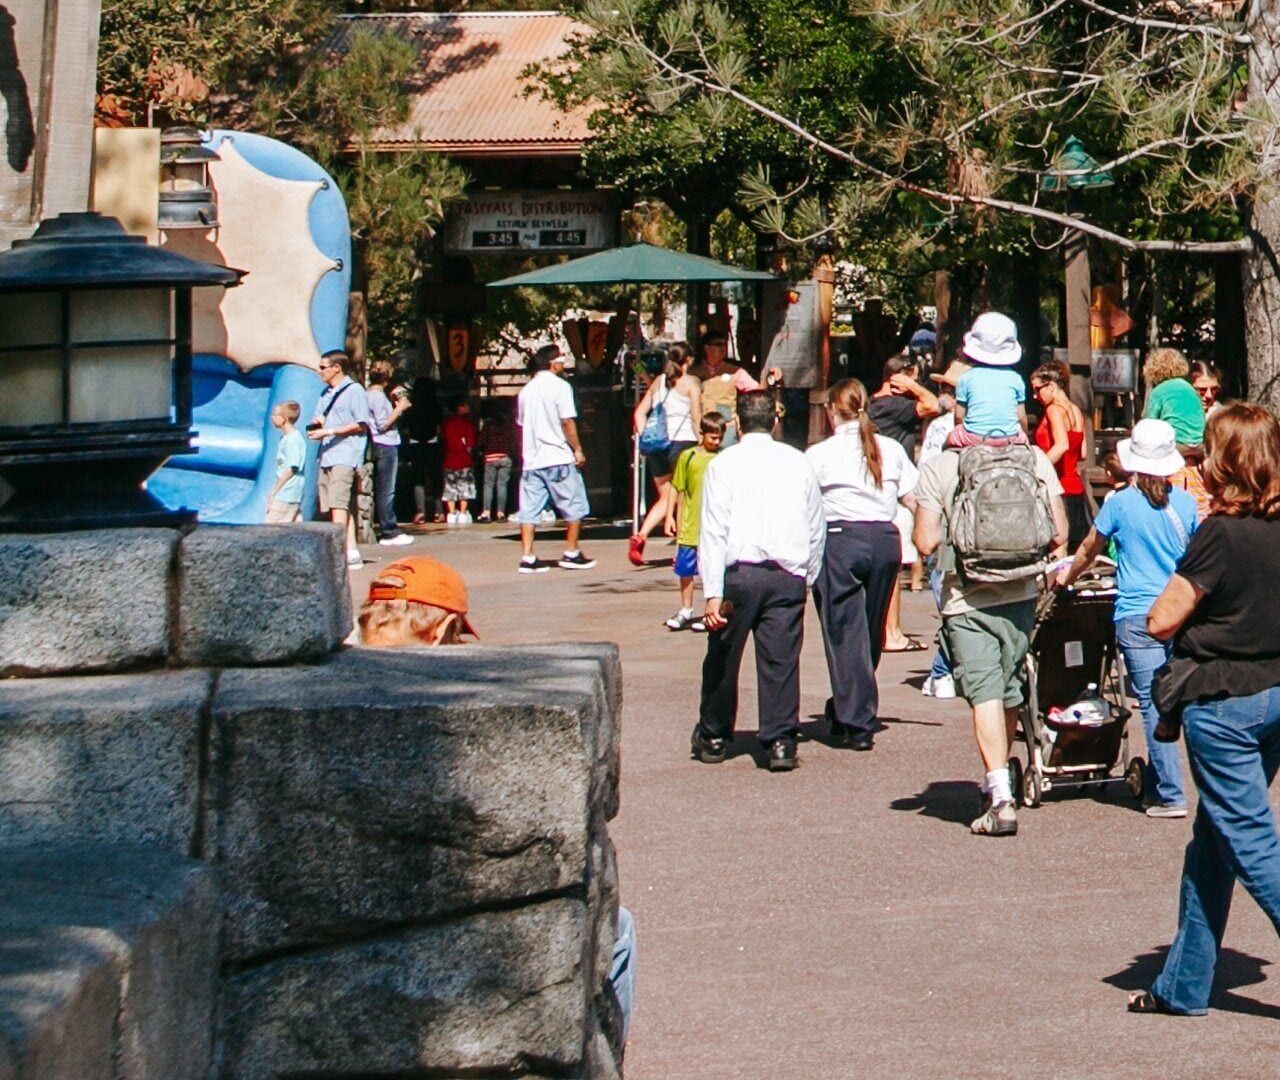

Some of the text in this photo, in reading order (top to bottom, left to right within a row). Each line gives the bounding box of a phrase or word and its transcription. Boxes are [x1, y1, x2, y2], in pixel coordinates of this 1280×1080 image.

[521, 199, 603, 216] DISTRIBUTION
[496, 219, 569, 229] RETURN BETWEEN
[488, 232, 513, 245] 3:45
[556, 231, 580, 244] 4:45
